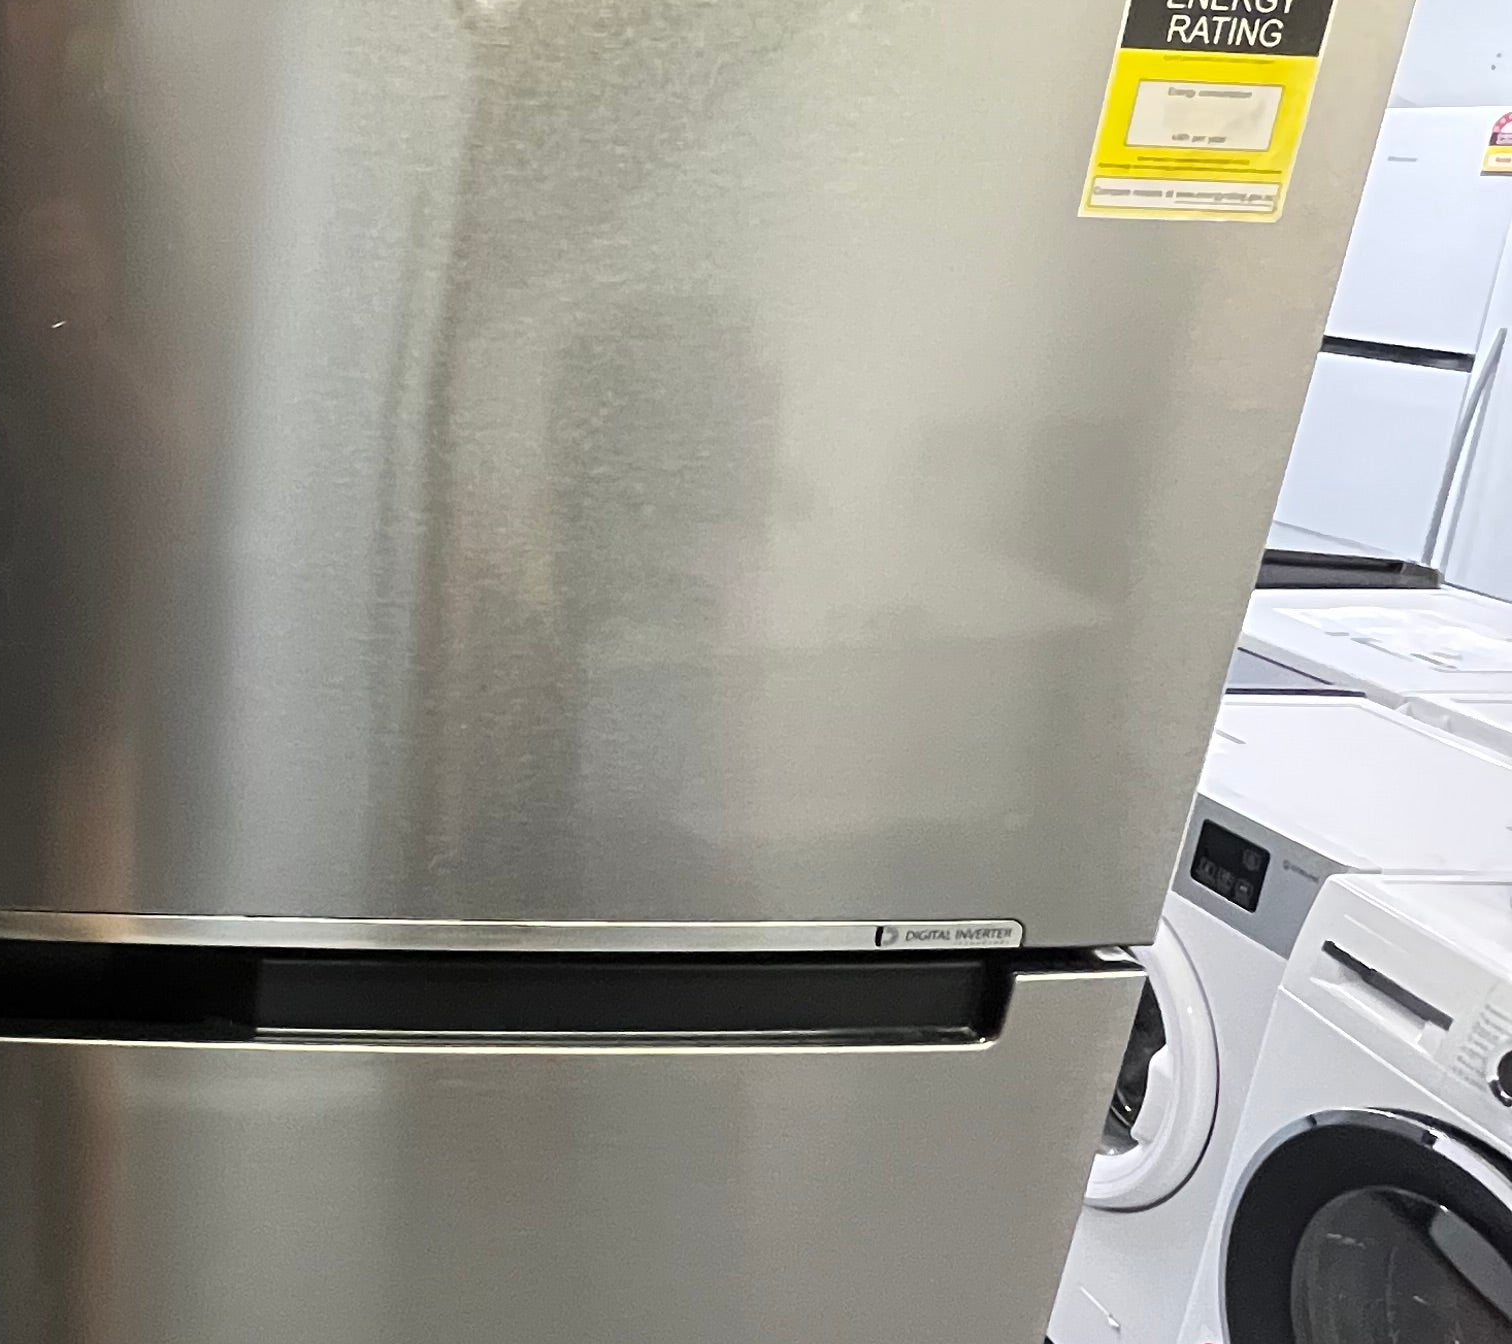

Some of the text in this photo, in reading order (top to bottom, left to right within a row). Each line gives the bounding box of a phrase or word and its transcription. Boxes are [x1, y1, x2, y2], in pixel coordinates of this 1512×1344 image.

[1166, 14, 1284, 48] RATING
[905, 927, 1012, 941] DIGITAL INVERTER
